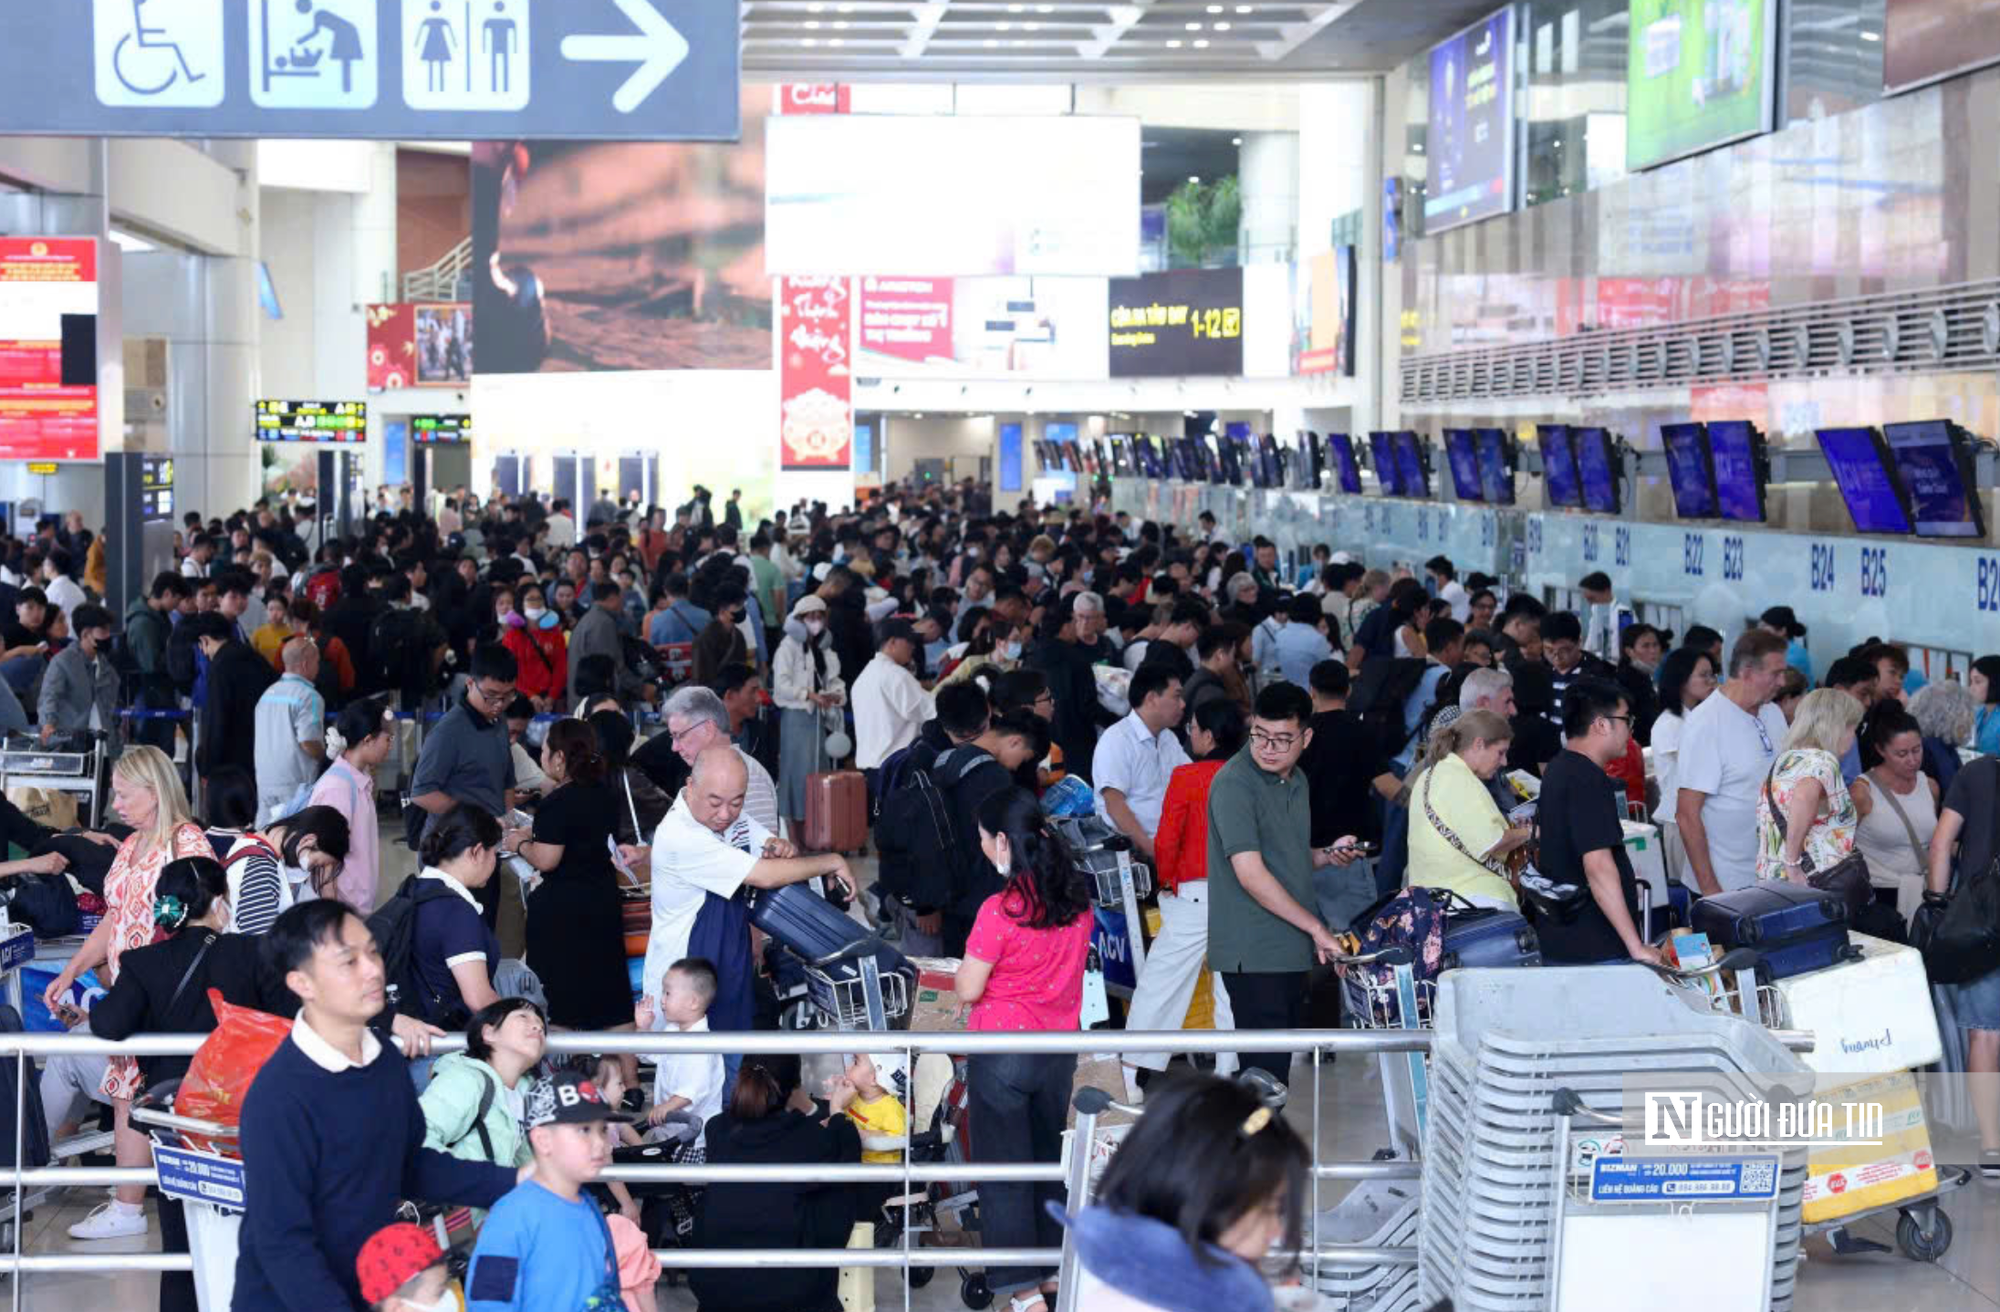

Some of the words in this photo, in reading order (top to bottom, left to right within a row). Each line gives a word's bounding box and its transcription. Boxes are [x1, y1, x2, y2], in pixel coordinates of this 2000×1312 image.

[1190, 308, 1222, 339] 1-12
[1685, 534, 1703, 575] B22
[1724, 537, 1744, 581] B23
[1811, 544, 1834, 591] B24
[1861, 548, 1886, 598] B25
[1978, 557, 2000, 612] B2
[1099, 930, 1126, 963] ACV
[1652, 1162, 1688, 1177] 20.000
